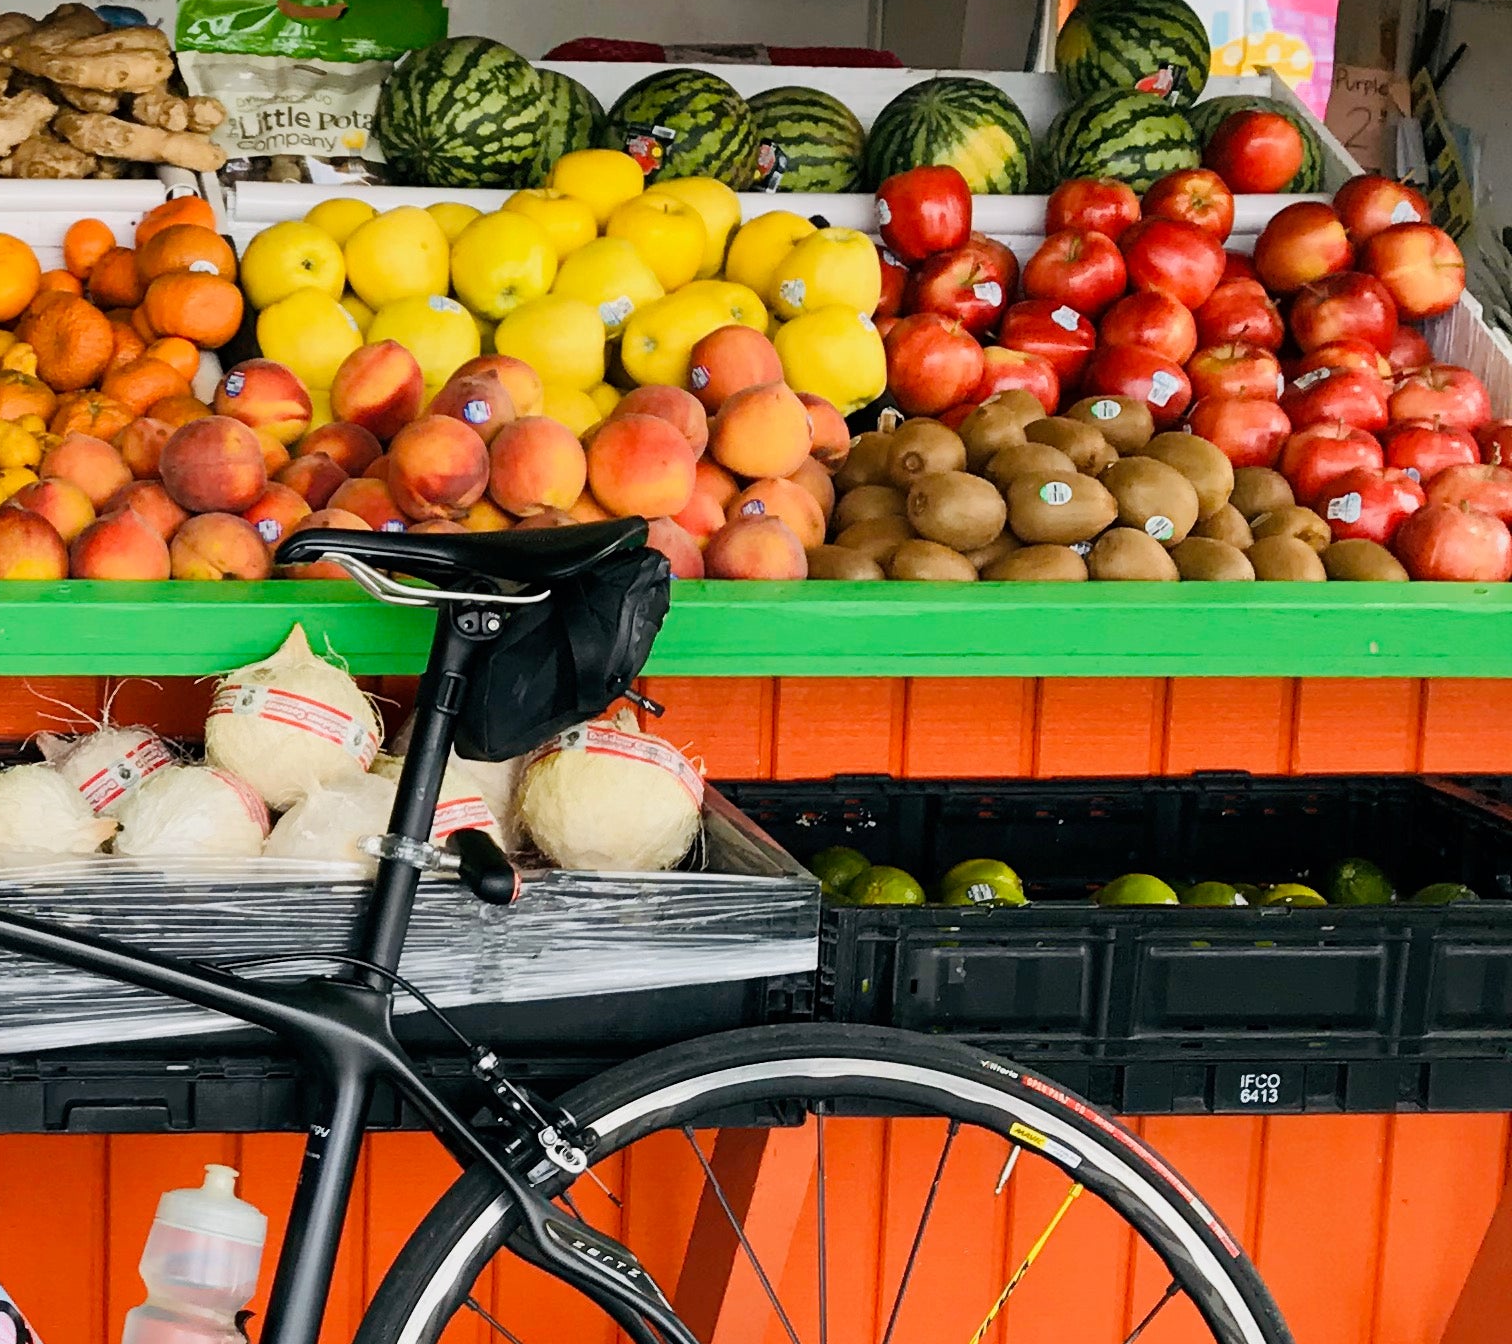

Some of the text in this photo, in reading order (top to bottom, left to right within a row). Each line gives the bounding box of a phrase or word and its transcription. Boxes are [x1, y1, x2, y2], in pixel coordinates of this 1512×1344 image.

[241, 106, 311, 140] Little
[1240, 1074, 1281, 1089] IFCO
[1240, 1088, 1279, 1103] 6413
